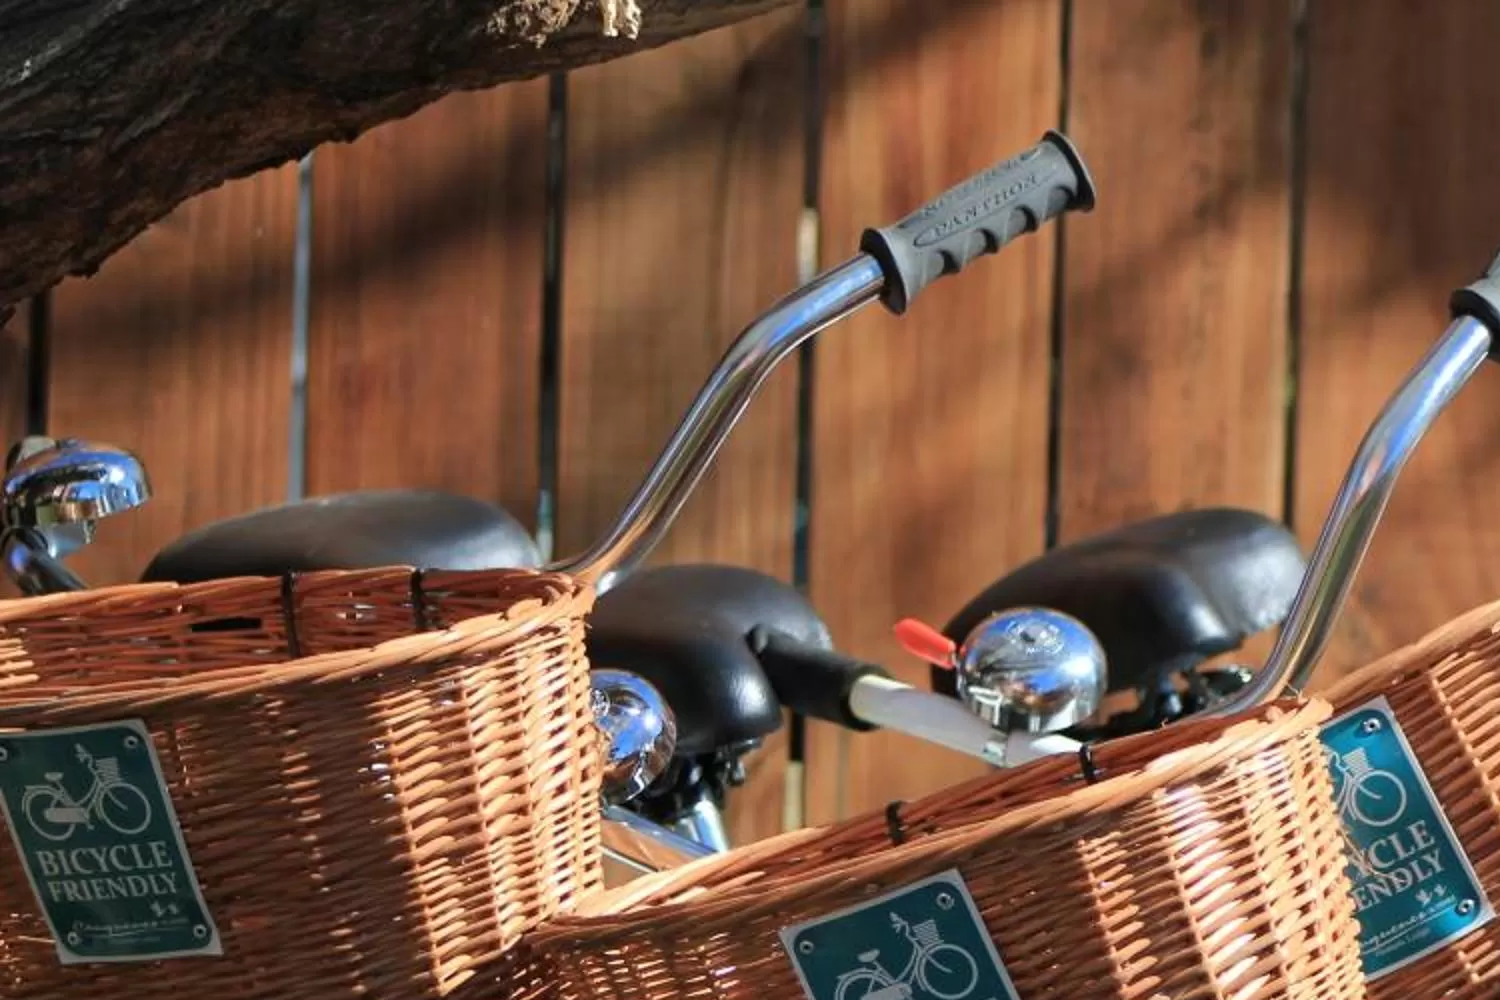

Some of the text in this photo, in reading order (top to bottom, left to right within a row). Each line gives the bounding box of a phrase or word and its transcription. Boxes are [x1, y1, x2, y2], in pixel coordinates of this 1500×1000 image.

[36, 841, 173, 876] BICYCLE
[1347, 819, 1435, 877] YCLE
[48, 872, 177, 902] FRIENDLY
[1351, 848, 1444, 912] ENDLY
